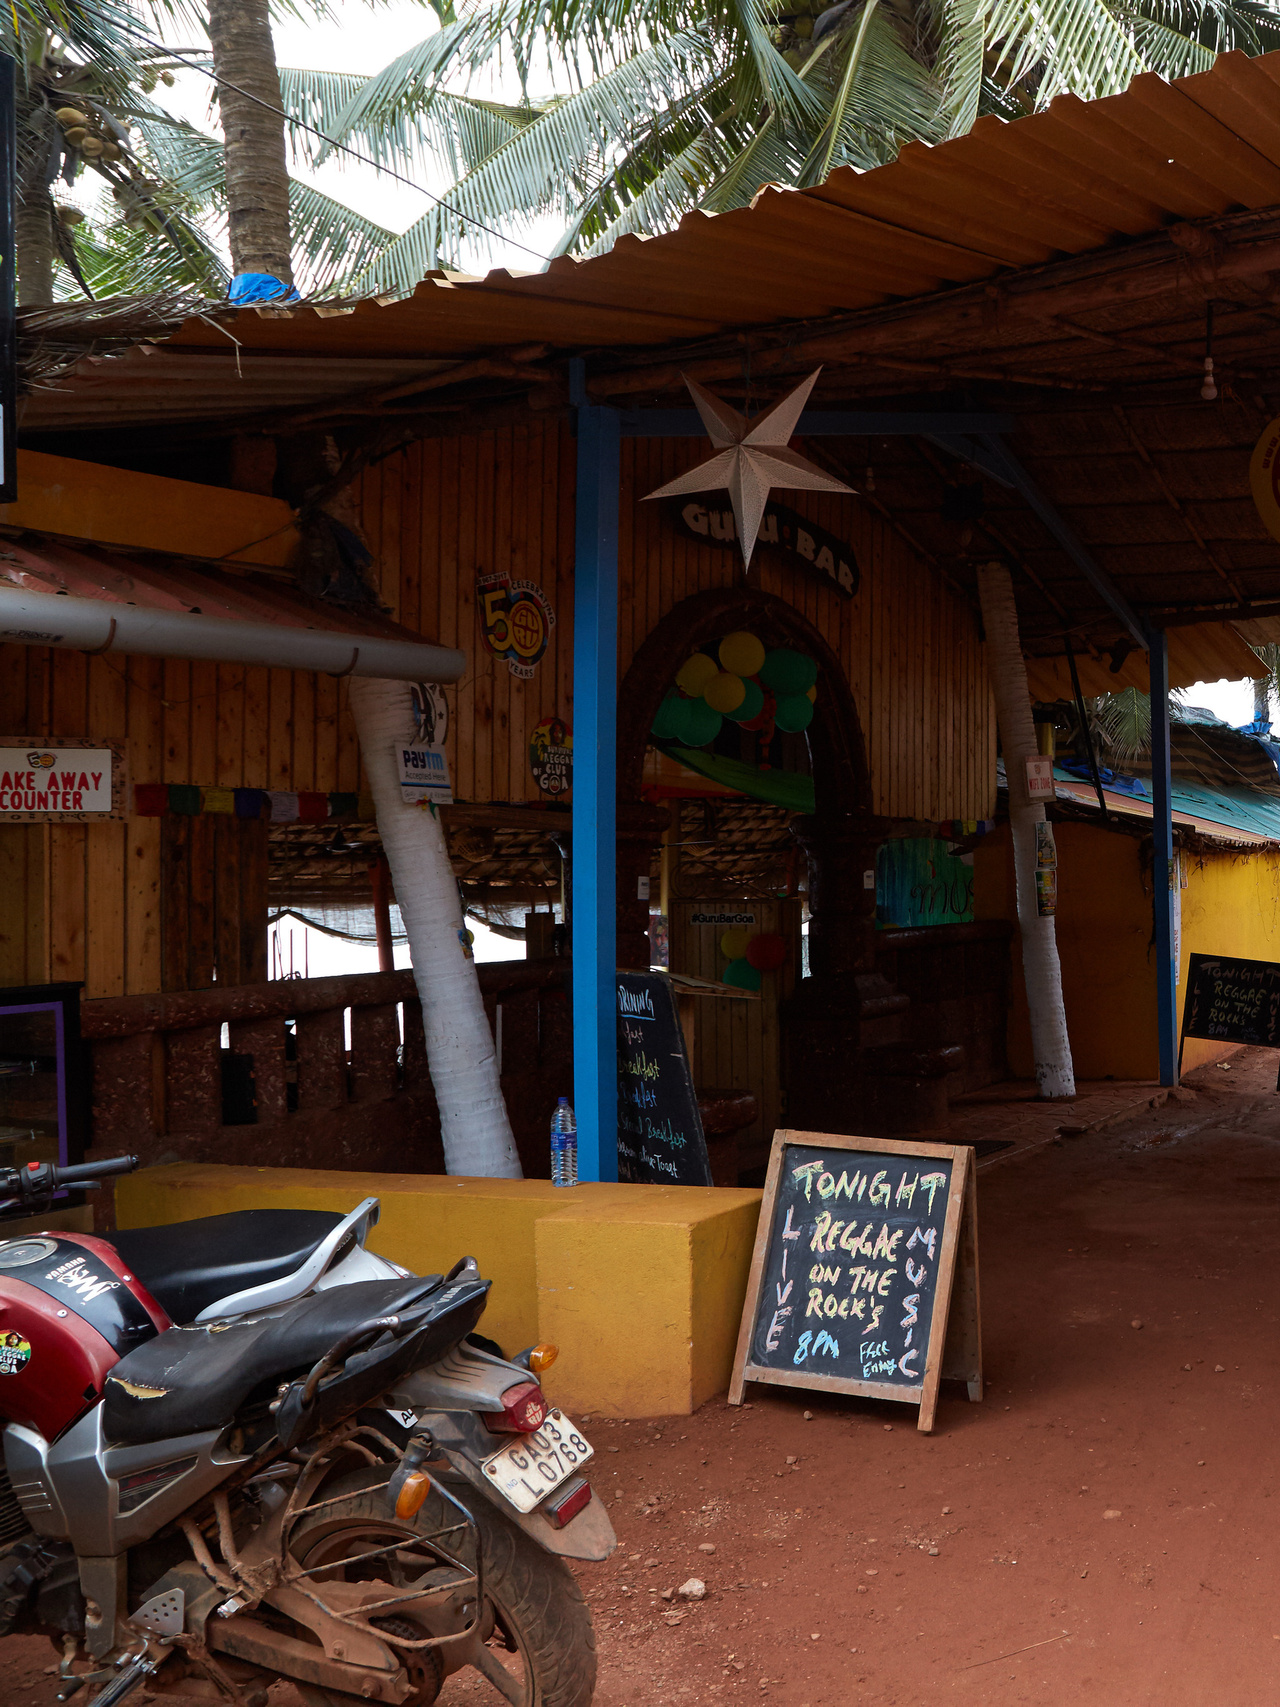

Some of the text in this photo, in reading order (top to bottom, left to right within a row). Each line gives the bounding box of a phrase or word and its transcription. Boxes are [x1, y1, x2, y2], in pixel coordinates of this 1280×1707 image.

[681, 503, 855, 595] GUU BAR
[512, 580, 556, 625] CELEBRATING
[509, 661, 534, 678] YEARS
[47, 771, 103, 791] AWAY
[405, 771, 447, 782] Accepted Here
[540, 774, 569, 793] GOA
[0, 790, 83, 811] COUNTER
[692, 913, 754, 923] #GuruBarGoa
[1213, 980, 1267, 1006] REGGAE
[1214, 999, 1261, 1018] ON THE
[792, 1160, 947, 1216] TONIGHT
[810, 1210, 905, 1262] REGGAE
[44, 1256, 87, 1280] YAMAHA
[765, 1204, 801, 1353] LIVE
[809, 1263, 898, 1297] ON THE
[898, 1225, 938, 1378] MUSIC
[793, 1329, 840, 1365] 8PM
